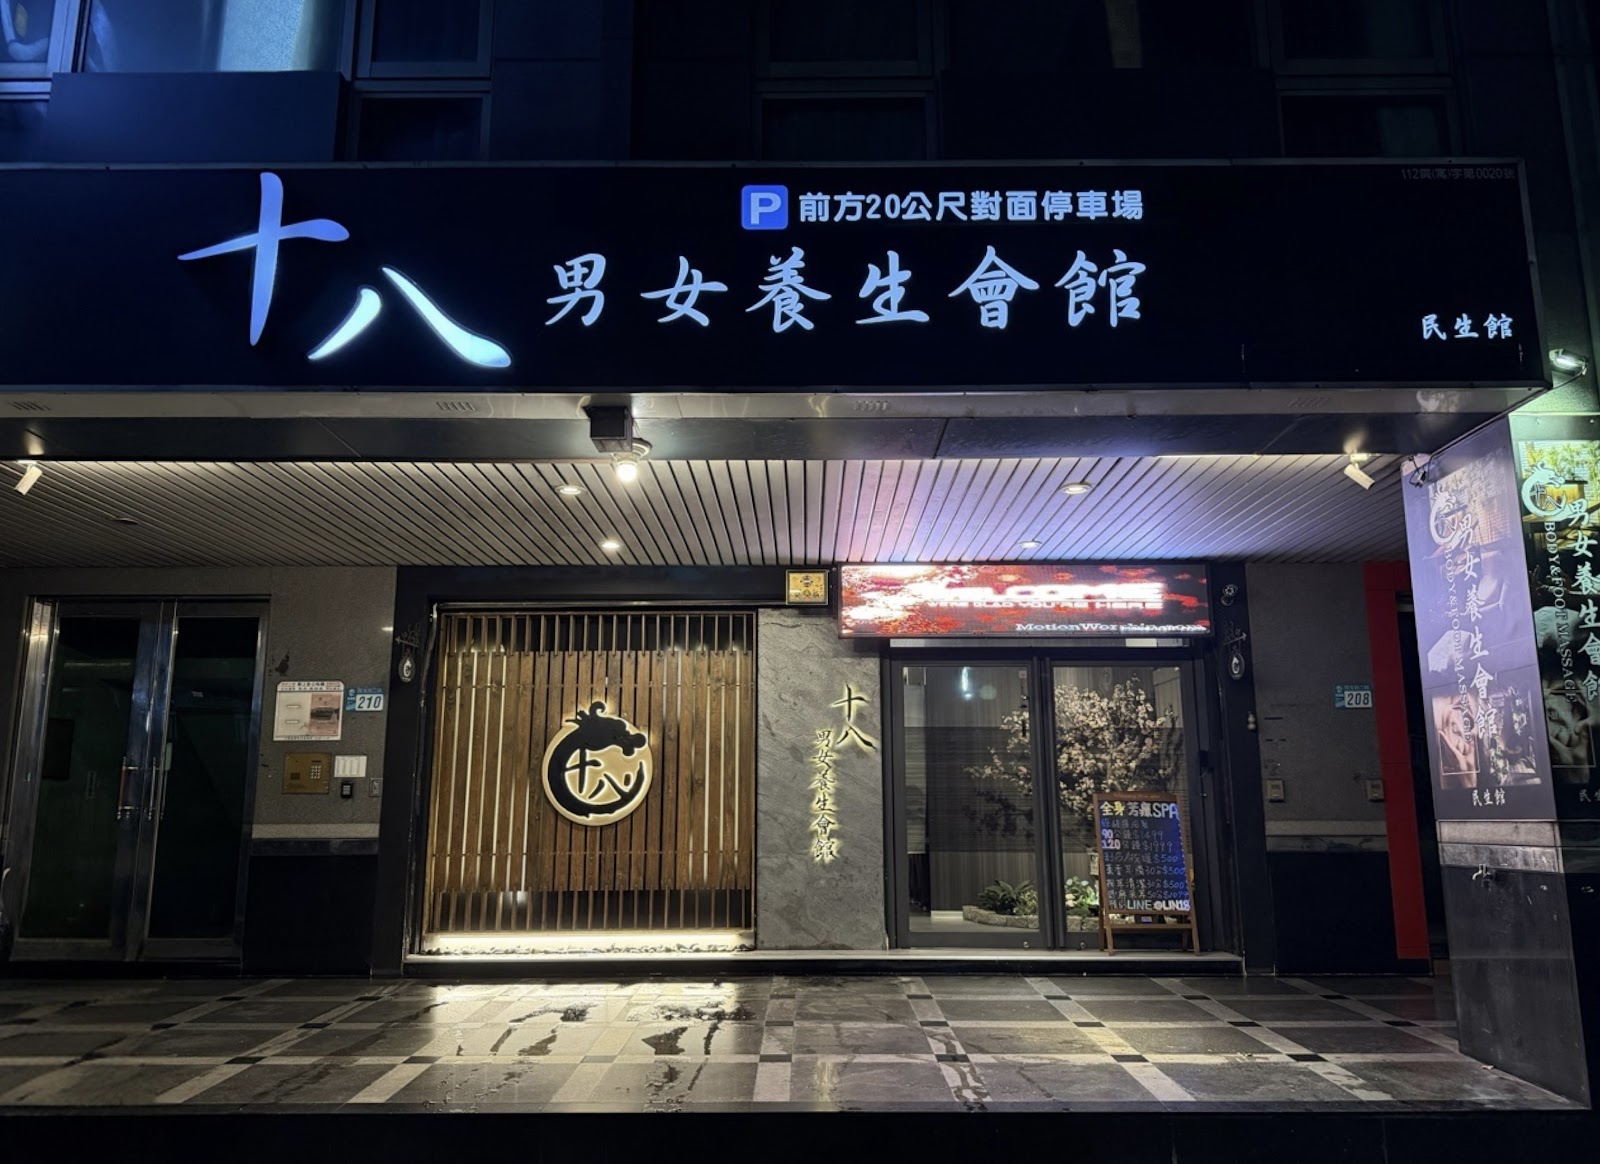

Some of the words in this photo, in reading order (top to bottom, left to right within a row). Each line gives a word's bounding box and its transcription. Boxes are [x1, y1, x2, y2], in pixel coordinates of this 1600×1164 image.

[750, 192, 782, 225] P
[799, 190, 1144, 222] 前方20公尺對面停車場
[177, 172, 512, 369] 十八
[545, 245, 1147, 333] 男女養生會館
[1422, 313, 1513, 340] 民生館
[1458, 514, 1498, 739] 男女養生會館
[357, 695, 382, 709] 210
[832, 684, 877, 749] 十八
[1347, 692, 1370, 705] 208
[810, 729, 838, 860] 男女養生會館
[1472, 788, 1506, 807] 民生館
